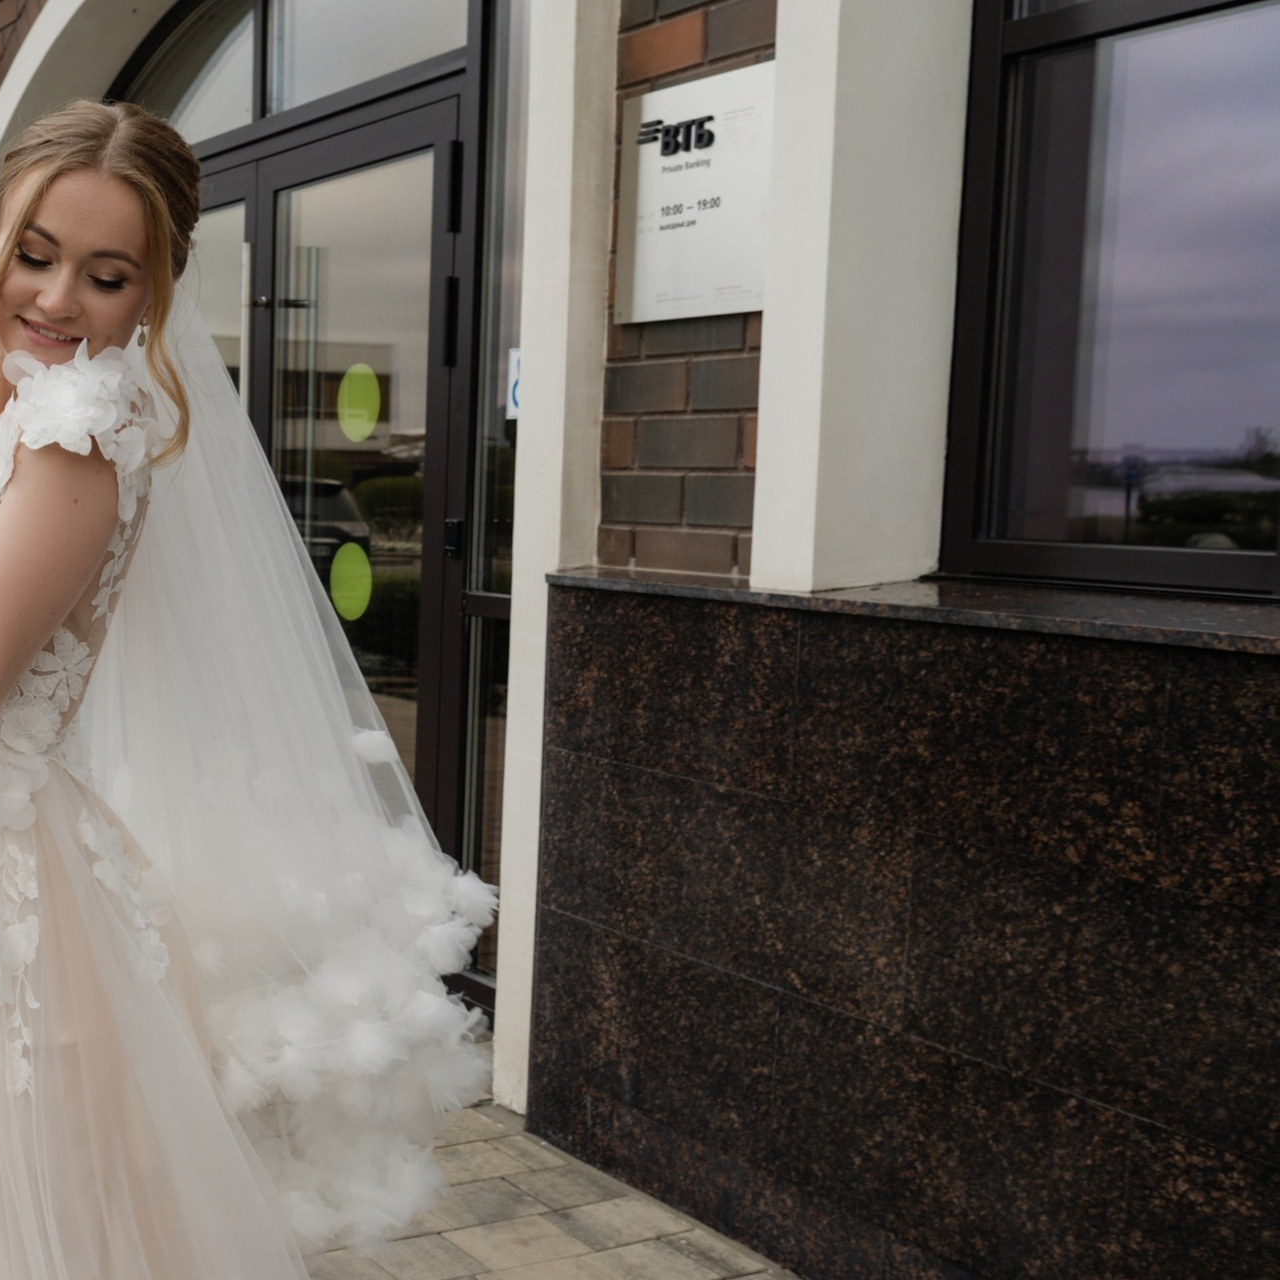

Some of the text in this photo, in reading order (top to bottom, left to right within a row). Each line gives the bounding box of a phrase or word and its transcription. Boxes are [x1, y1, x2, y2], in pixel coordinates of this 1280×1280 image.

[661, 115, 715, 157] ВТБ
[661, 159, 711, 174] Private Banking
[661, 203, 683, 217] 10:00
[697, 196, 721, 210] 19:00
